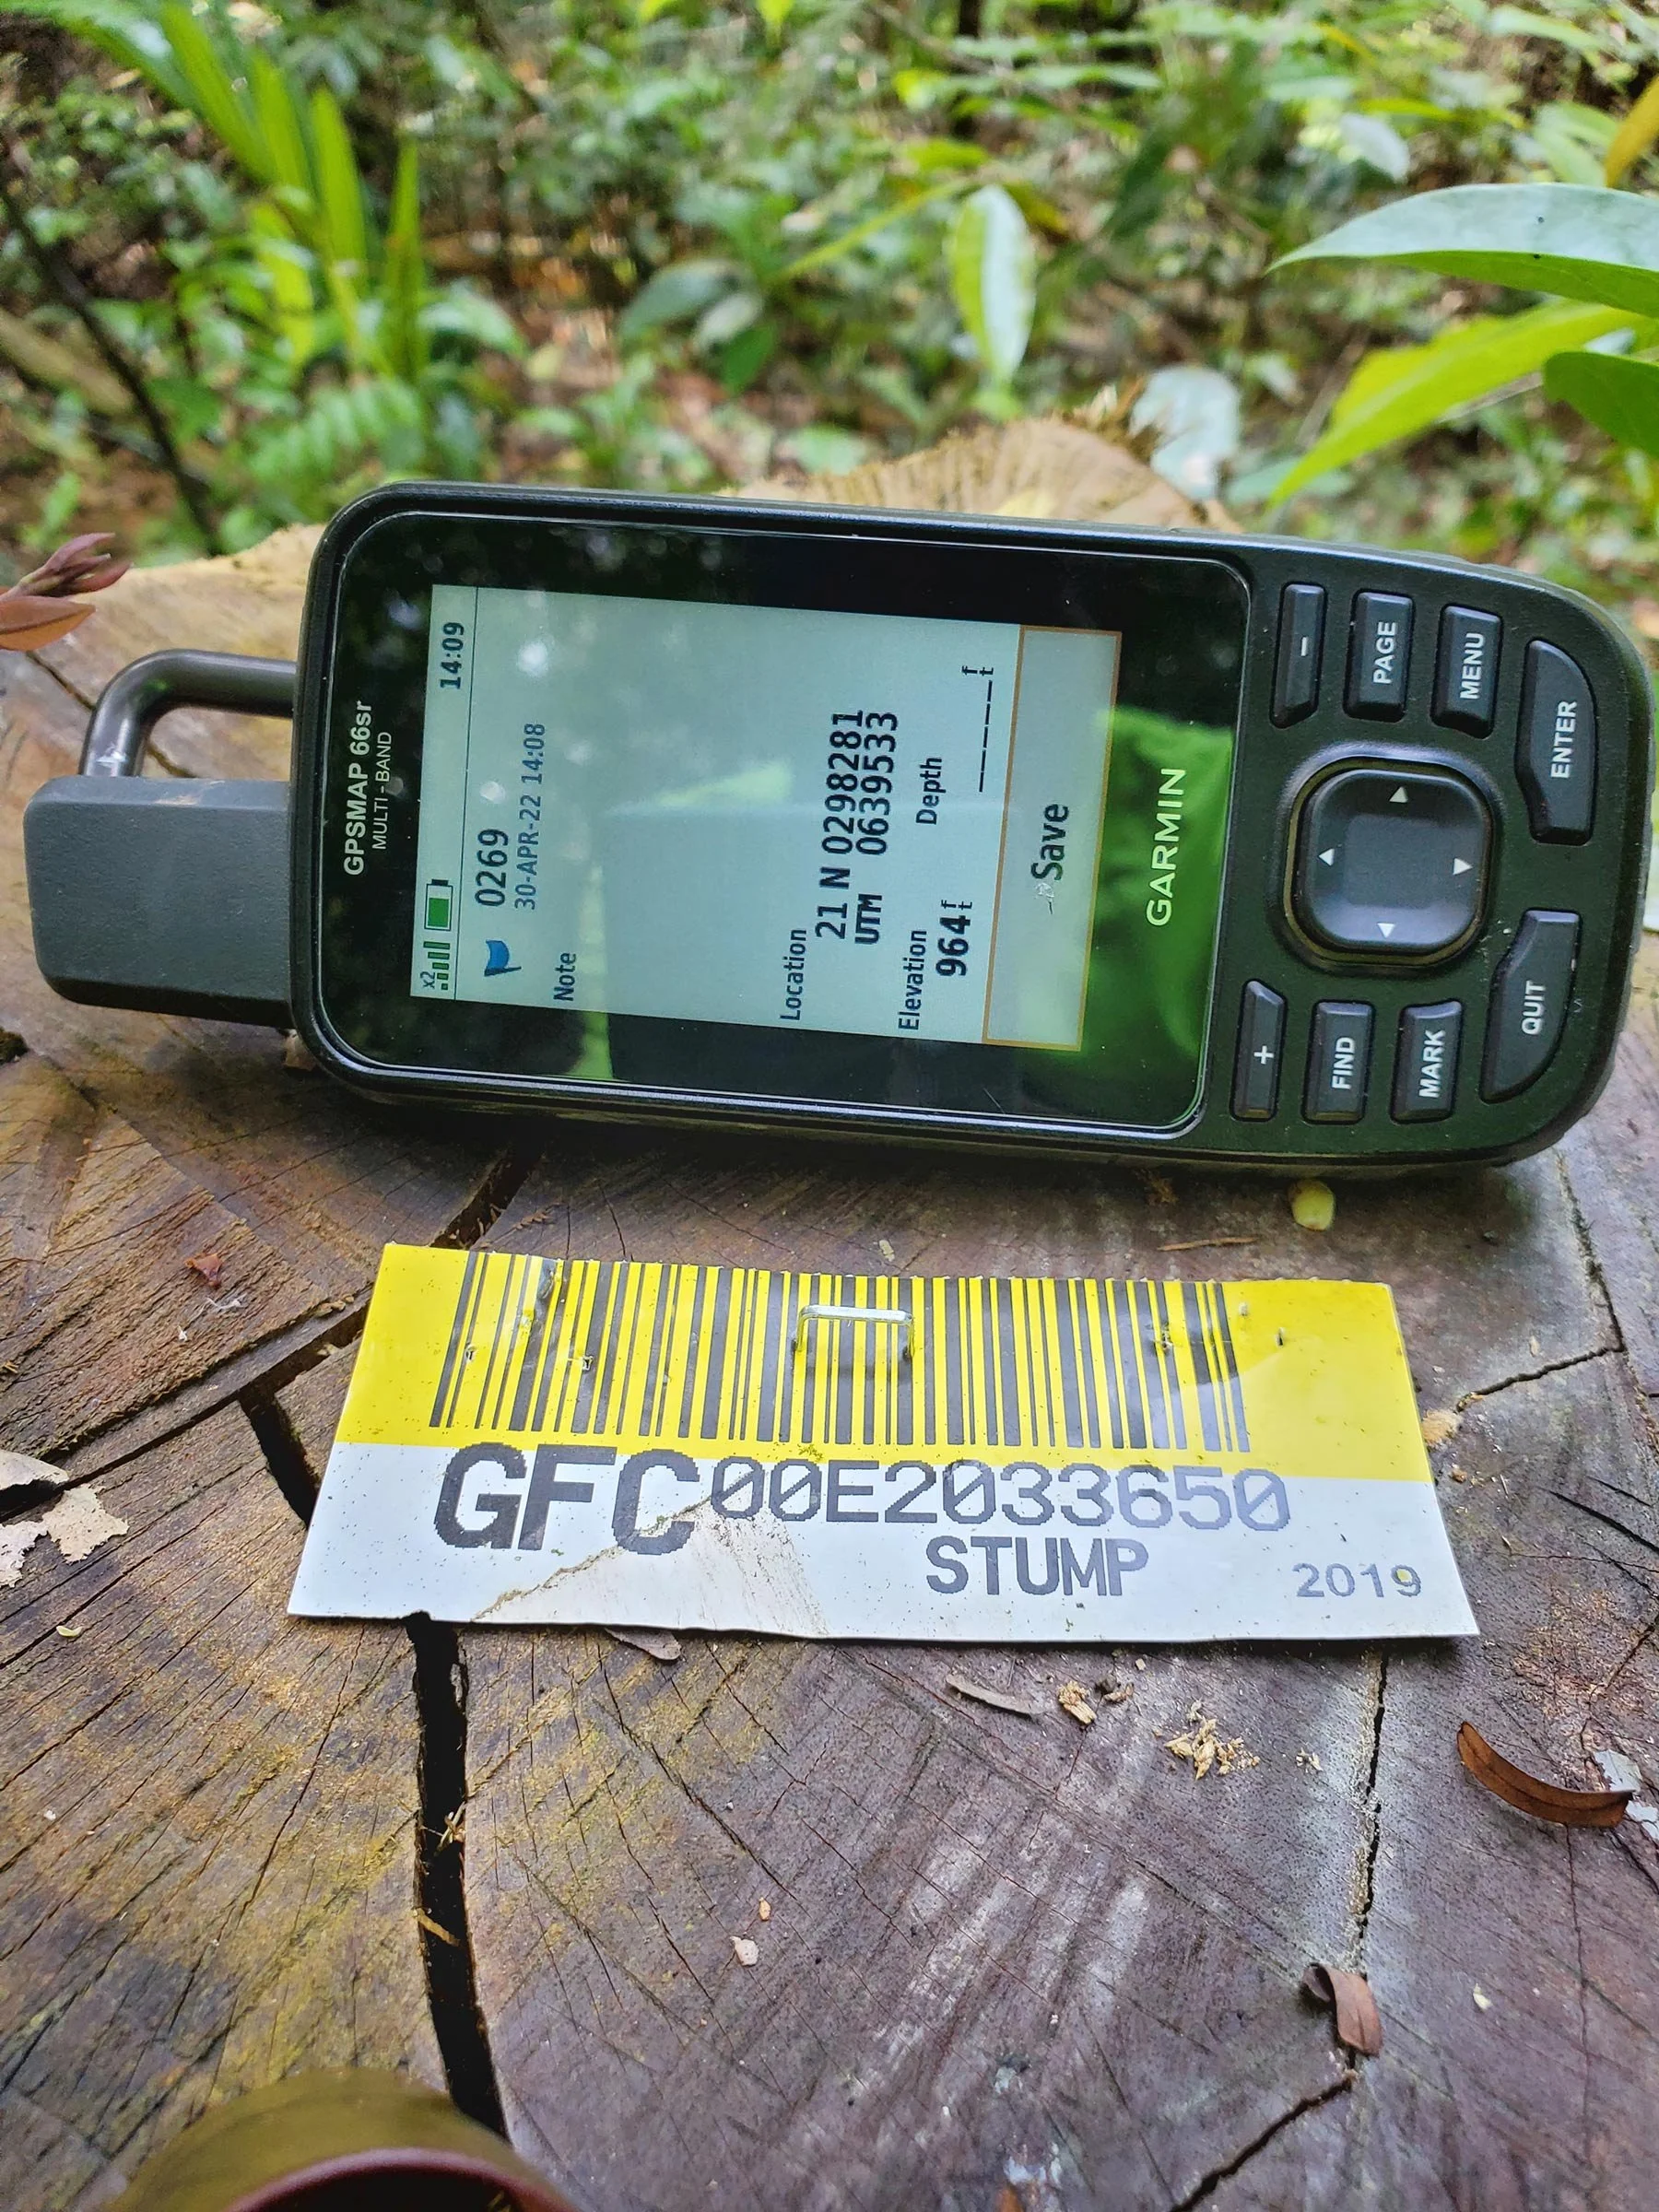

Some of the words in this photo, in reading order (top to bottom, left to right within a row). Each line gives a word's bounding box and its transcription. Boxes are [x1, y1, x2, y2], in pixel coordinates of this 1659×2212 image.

[440, 621, 465, 690] 14:09
[1373, 621, 1397, 685] PAGE
[1460, 631, 1485, 700] MENU
[349, 700, 372, 756] 66sr
[524, 723, 546, 785] 14:08
[1550, 699, 1577, 779] ENTER
[821, 709, 864, 854] 0298281
[854, 711, 898, 855] 0639533
[915, 757, 947, 826] Depth
[343, 762, 369, 876] GPSMAP
[514, 794, 542, 911] 30-APR-22
[1030, 803, 1069, 881] Save
[1146, 768, 1186, 926] GARMIN
[475, 829, 509, 907] 0269
[819, 867, 851, 890] N
[815, 901, 848, 940] 21
[853, 893, 883, 946] UTM
[935, 915, 971, 977] 964
[553, 951, 577, 1002] Note
[780, 928, 807, 1020] Location
[898, 929, 928, 1030] Elevation
[1521, 980, 1547, 1037] QUIT
[1332, 1036, 1355, 1090] FIND
[1418, 1030, 1447, 1099] MARK
[925, 1535, 1149, 1597] STUMP
[1291, 1563, 1423, 1598] 2019
